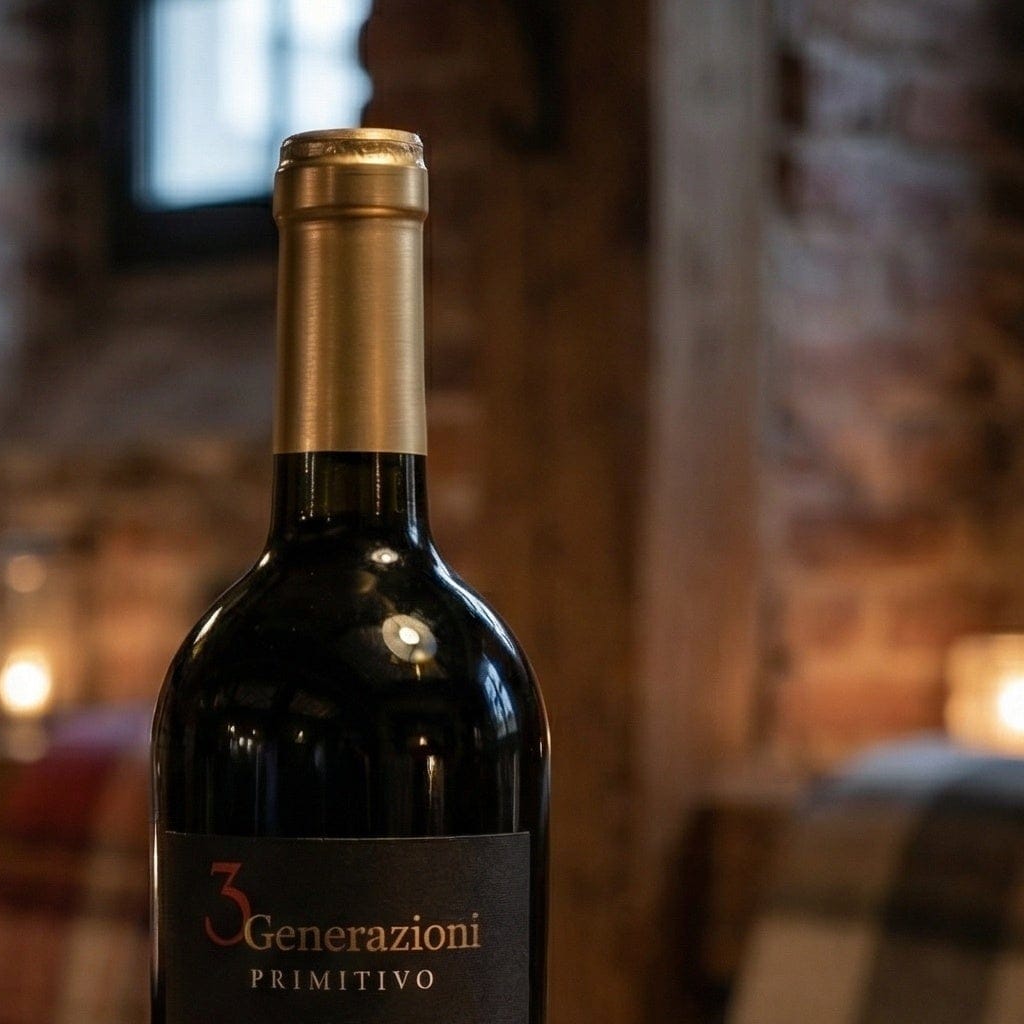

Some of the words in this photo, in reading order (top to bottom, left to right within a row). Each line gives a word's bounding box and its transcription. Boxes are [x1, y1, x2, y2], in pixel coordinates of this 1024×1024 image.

[204, 861, 252, 946] 3
[244, 913, 481, 951] Generazioni
[250, 968, 434, 990] PRIMITIVO
